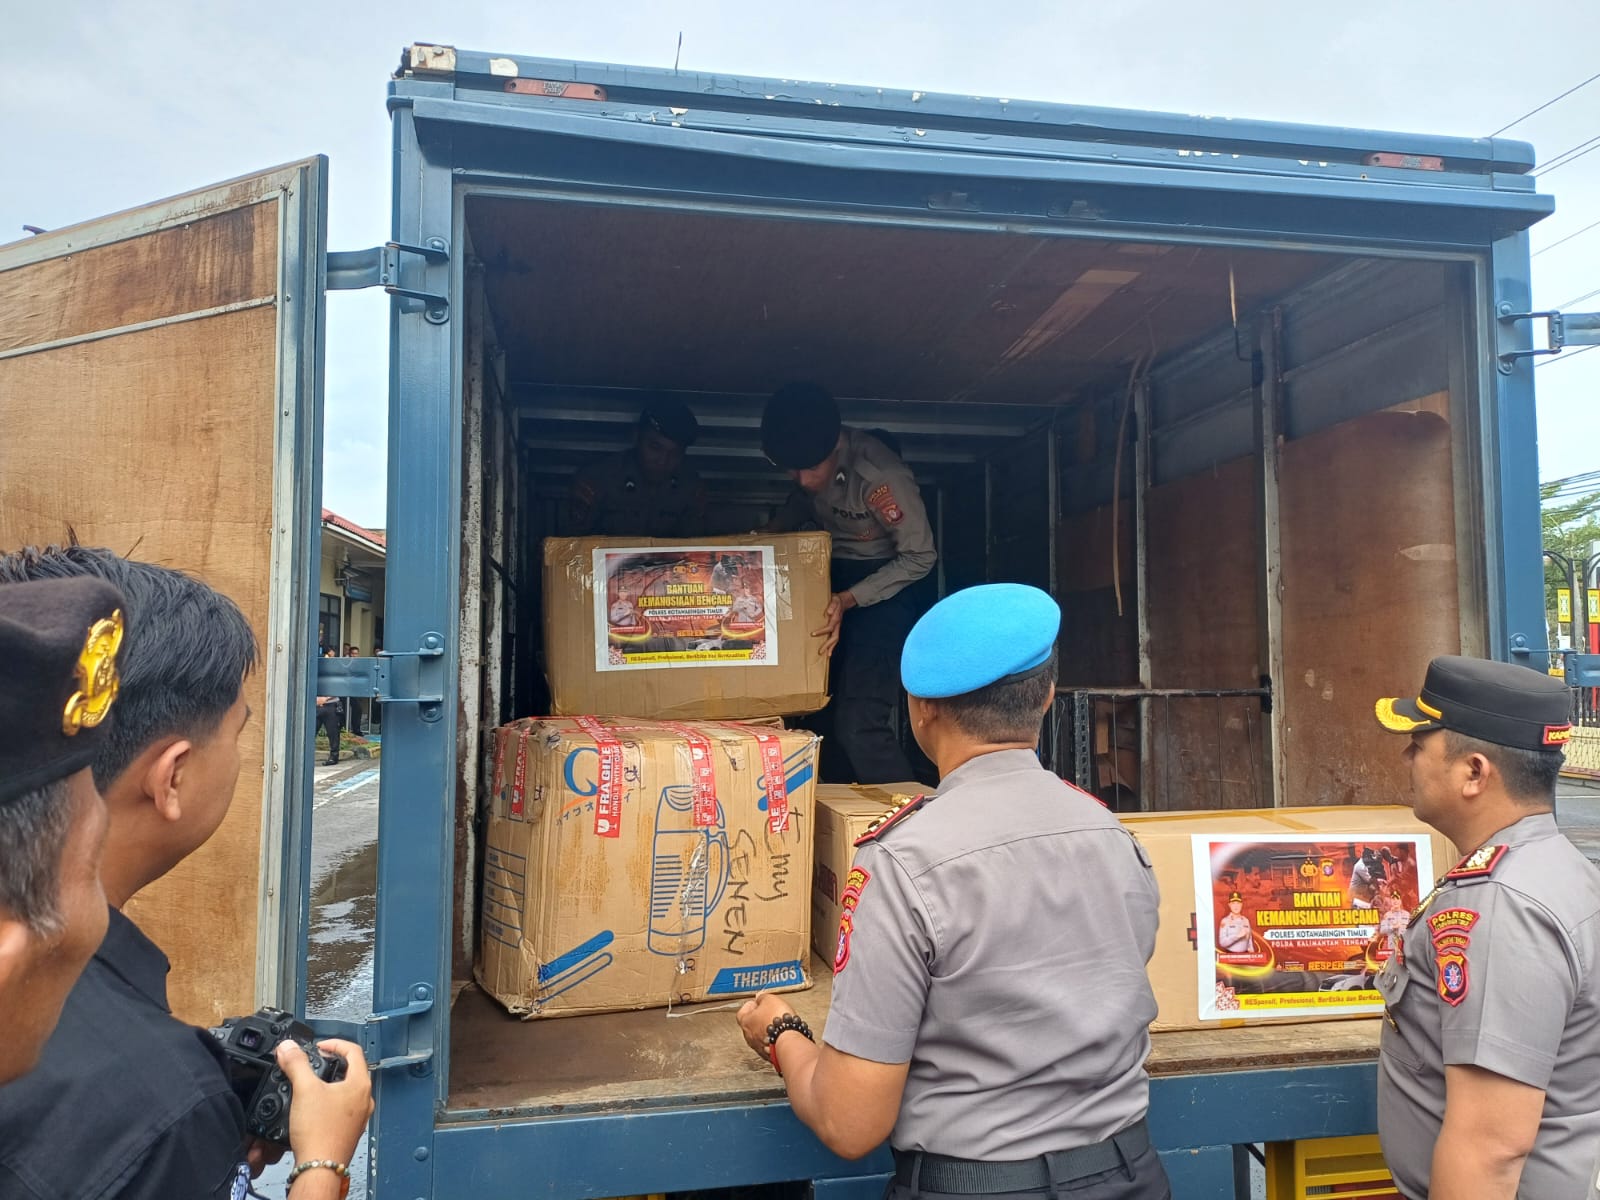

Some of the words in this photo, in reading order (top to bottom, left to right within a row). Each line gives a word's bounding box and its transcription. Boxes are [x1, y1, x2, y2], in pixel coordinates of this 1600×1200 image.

[666, 584, 704, 594] BANTUAN
[638, 596, 695, 607] KEMANUSIAAN
[696, 595, 733, 606] BENCANA
[599, 746, 612, 815] FRAGILE
[612, 764, 621, 785] WITH
[611, 786, 620, 817] HANDLE
[1293, 892, 1341, 908] BANTUAN
[1256, 910, 1331, 926] KEMANUSIAAN
[1332, 909, 1380, 925] BENCANA
[1431, 911, 1474, 926] POLRES
[1270, 931, 1295, 939] POLRES
[1296, 930, 1346, 938] KOTAWARINGIN
[1347, 929, 1368, 937] TIMUR
[1271, 940, 1294, 948] POLDA
[1308, 961, 1344, 971] RESPEK
[733, 966, 797, 988] THERMOS
